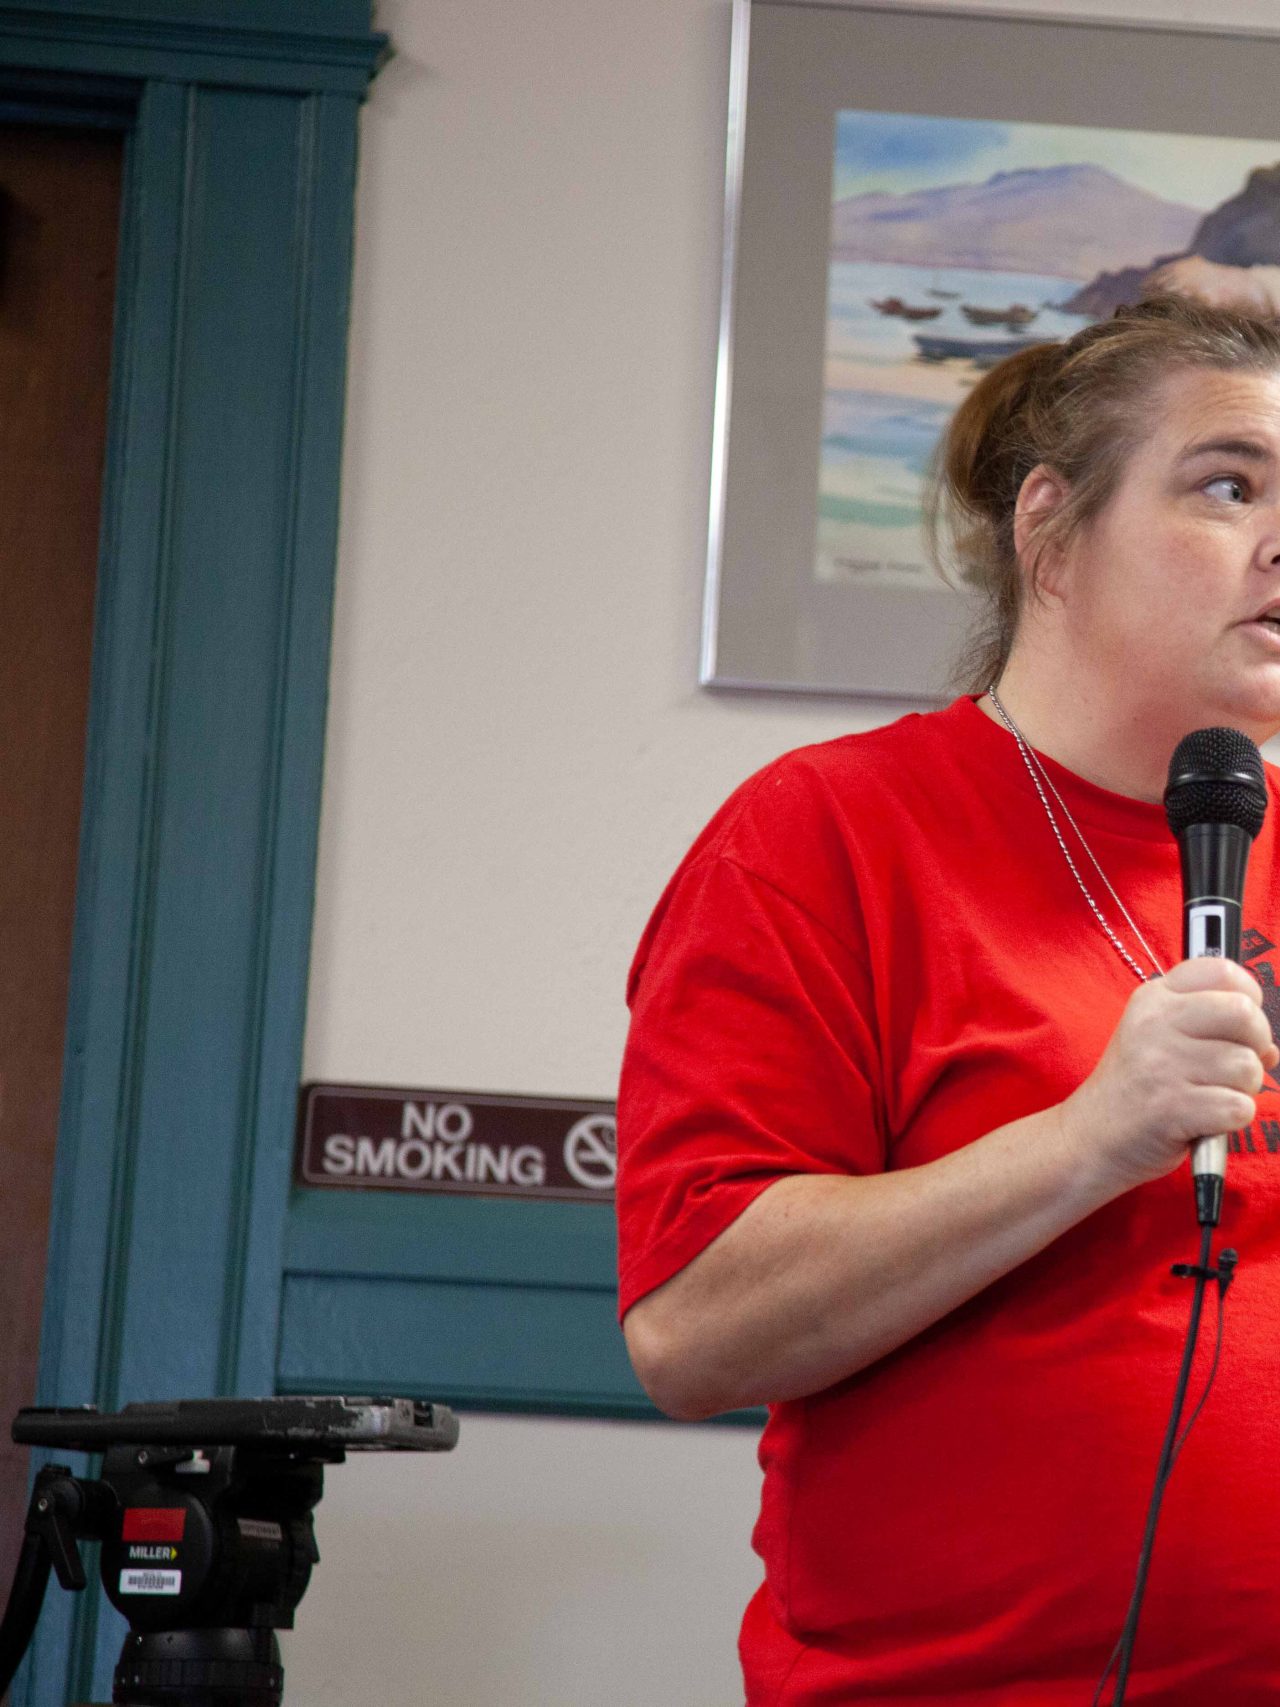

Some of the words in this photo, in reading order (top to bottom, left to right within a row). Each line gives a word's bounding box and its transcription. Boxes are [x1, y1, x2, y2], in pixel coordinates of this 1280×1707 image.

[401, 1101, 474, 1144] NO
[322, 1135, 546, 1187] SMOKING
[128, 1545, 170, 1560] MILLER
